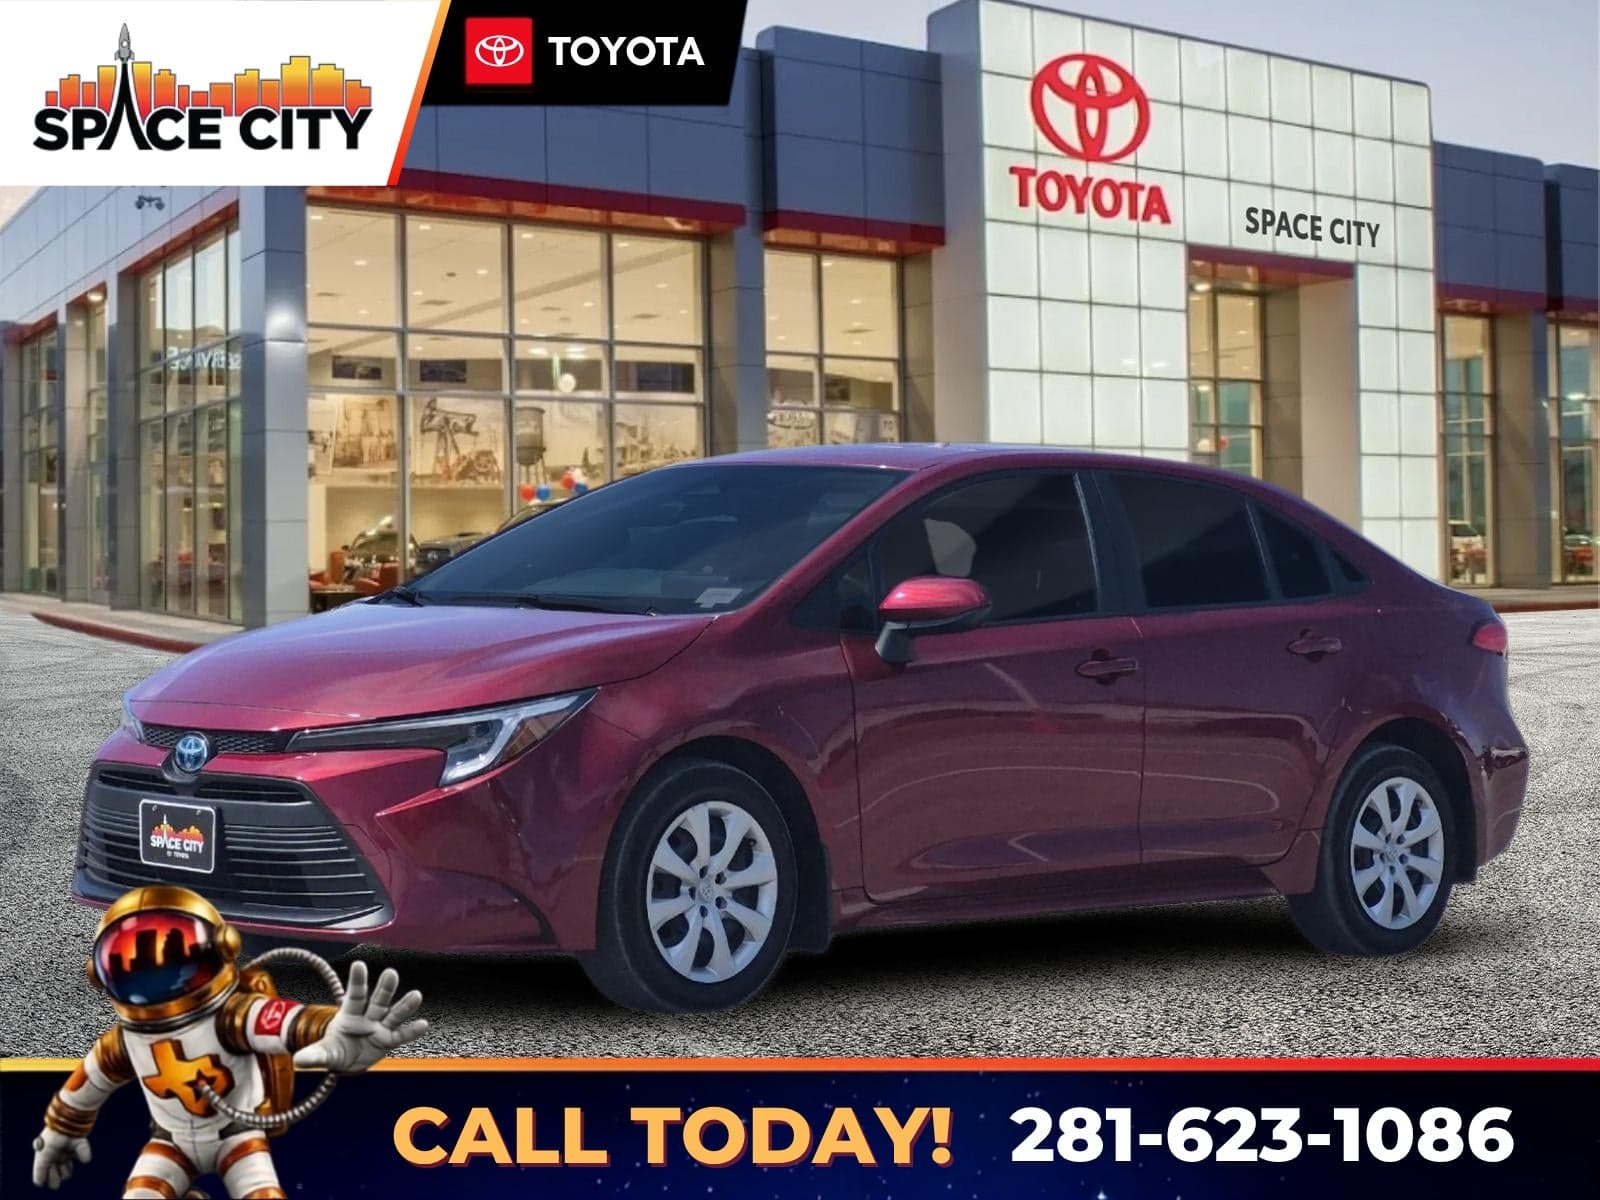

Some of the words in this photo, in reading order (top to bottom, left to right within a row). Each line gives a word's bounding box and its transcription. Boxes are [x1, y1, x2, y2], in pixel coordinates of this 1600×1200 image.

[1009, 167, 1172, 225] TOYOTA
[1245, 206, 1323, 242] SPACE
[1329, 218, 1381, 249] CITY
[150, 834, 182, 851] SPACE
[182, 838, 205, 854] CITY
